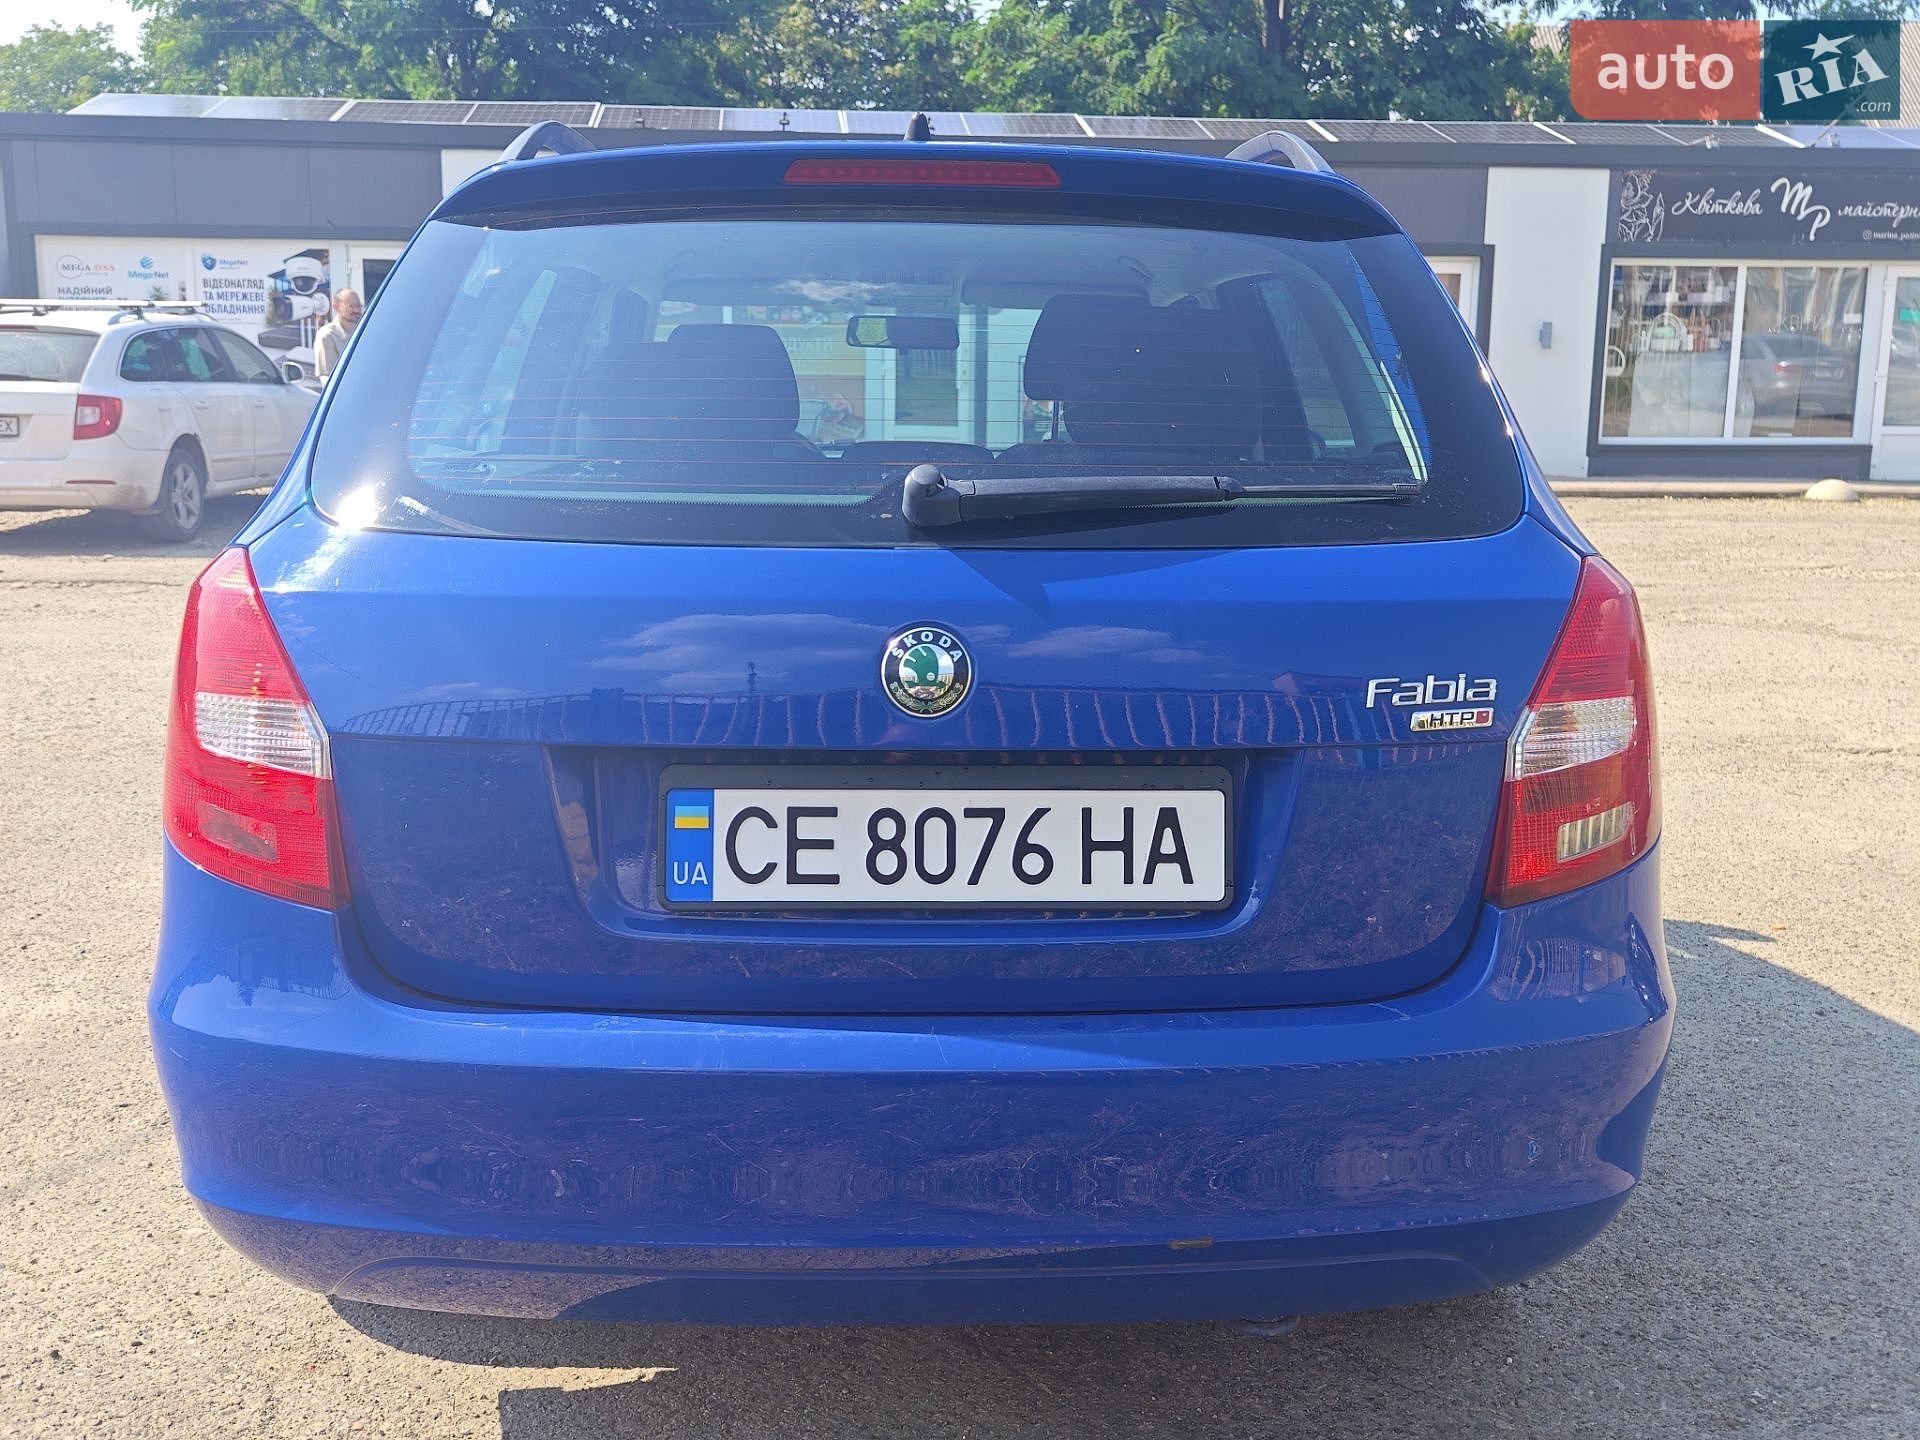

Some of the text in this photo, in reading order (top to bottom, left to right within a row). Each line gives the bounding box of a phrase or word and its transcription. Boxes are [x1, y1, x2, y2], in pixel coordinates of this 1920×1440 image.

[1671, 187, 1763, 216] Квіткова
[1838, 201, 1920, 228] майстерн
[58, 286, 113, 296] НАДІЙНИЙ
[203, 279, 265, 290] ВІДЕОНАГЛЯД
[204, 291, 265, 302] ТА МЕРЕЖЕВЕ
[205, 304, 266, 315] ОБЛАДНАННЯ
[1365, 673, 1498, 709] Fabia
[1429, 712, 1475, 727] HTP
[725, 806, 1194, 885] CE 8076 HA
[673, 862, 709, 885] UA
